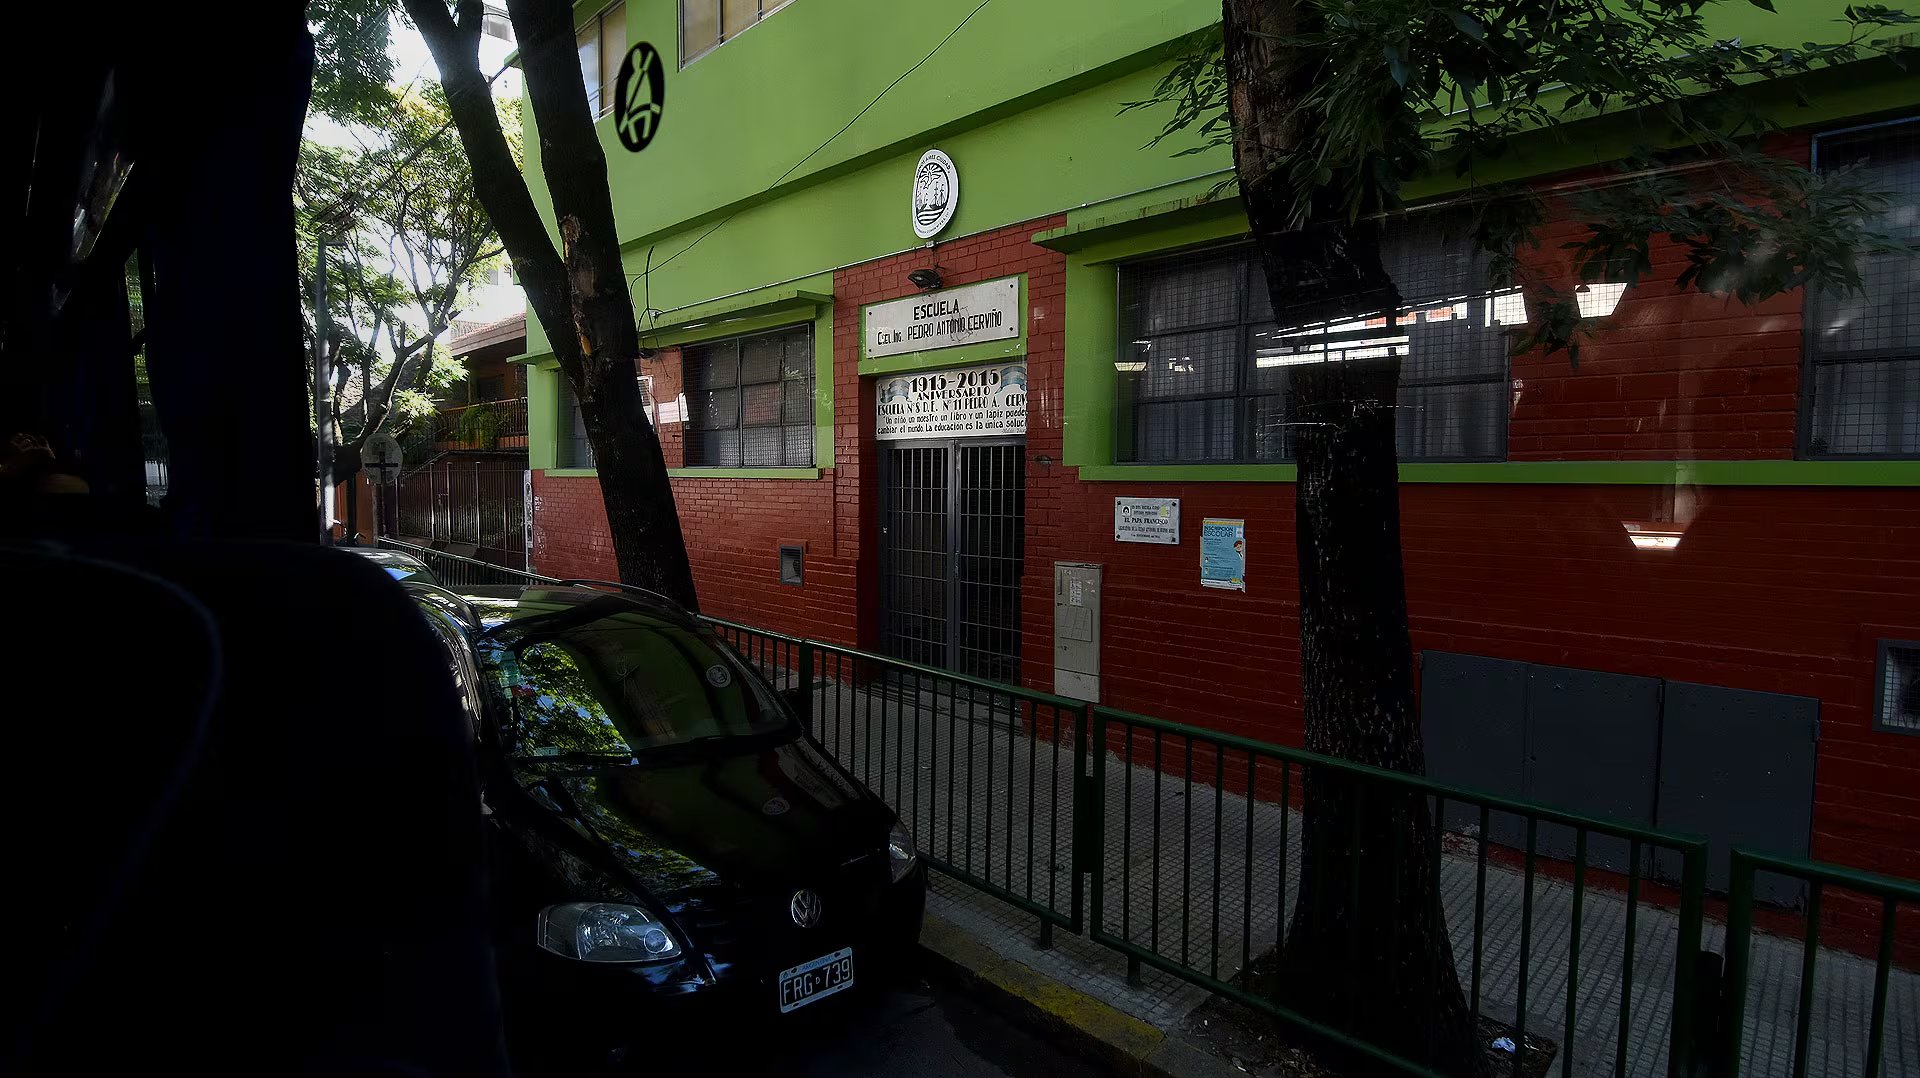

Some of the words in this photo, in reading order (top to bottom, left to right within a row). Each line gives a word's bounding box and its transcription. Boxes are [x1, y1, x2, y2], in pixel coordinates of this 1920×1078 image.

[913, 299, 960, 321] ESCUELA
[907, 322, 934, 341] PEDRO
[936, 316, 966, 336] ANTONIO
[967, 308, 1002, 331] CERVIÑO
[916, 386, 991, 401] ANIVERSARIO
[877, 403, 905, 416] ESCUELA
[964, 396, 989, 410] PEDRO
[991, 395, 1000, 408] A.
[899, 424, 906, 433] el
[925, 423, 933, 432] La
[965, 421, 973, 430] es
[975, 420, 983, 430] la
[940, 414, 948, 422] un
[950, 411, 967, 421] libro
[974, 411, 984, 420] un
[783, 973, 813, 1004] FRG
[822, 958, 850, 988] 739
